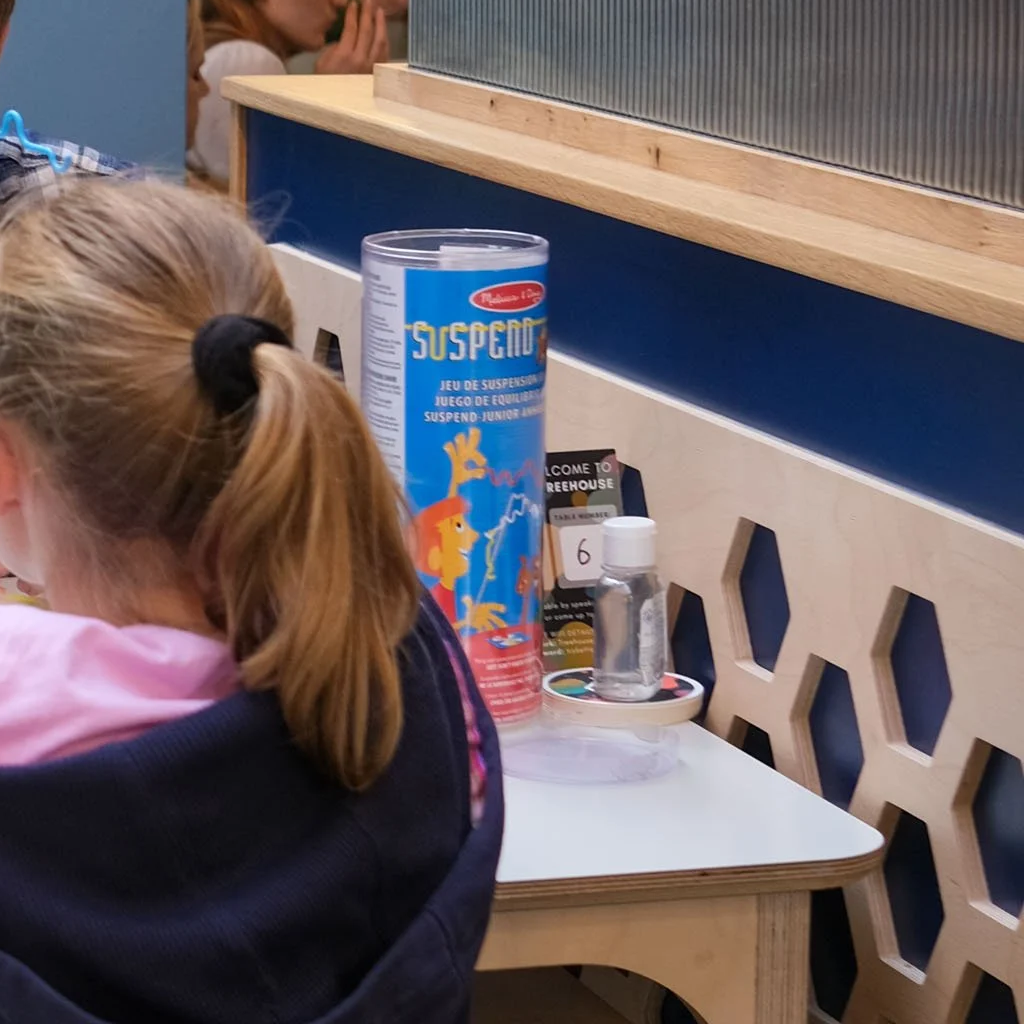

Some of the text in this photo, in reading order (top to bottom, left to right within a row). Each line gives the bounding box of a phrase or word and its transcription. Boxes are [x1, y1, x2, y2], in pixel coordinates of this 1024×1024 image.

[440, 380, 460, 391] JEU
[464, 380, 478, 391] DE
[434, 396, 472, 407] JUEGO
[475, 395, 489, 406] DE
[545, 461, 613, 477] LCOME TO
[546, 478, 615, 493] REEHOUSE
[577, 537, 591, 565] 6
